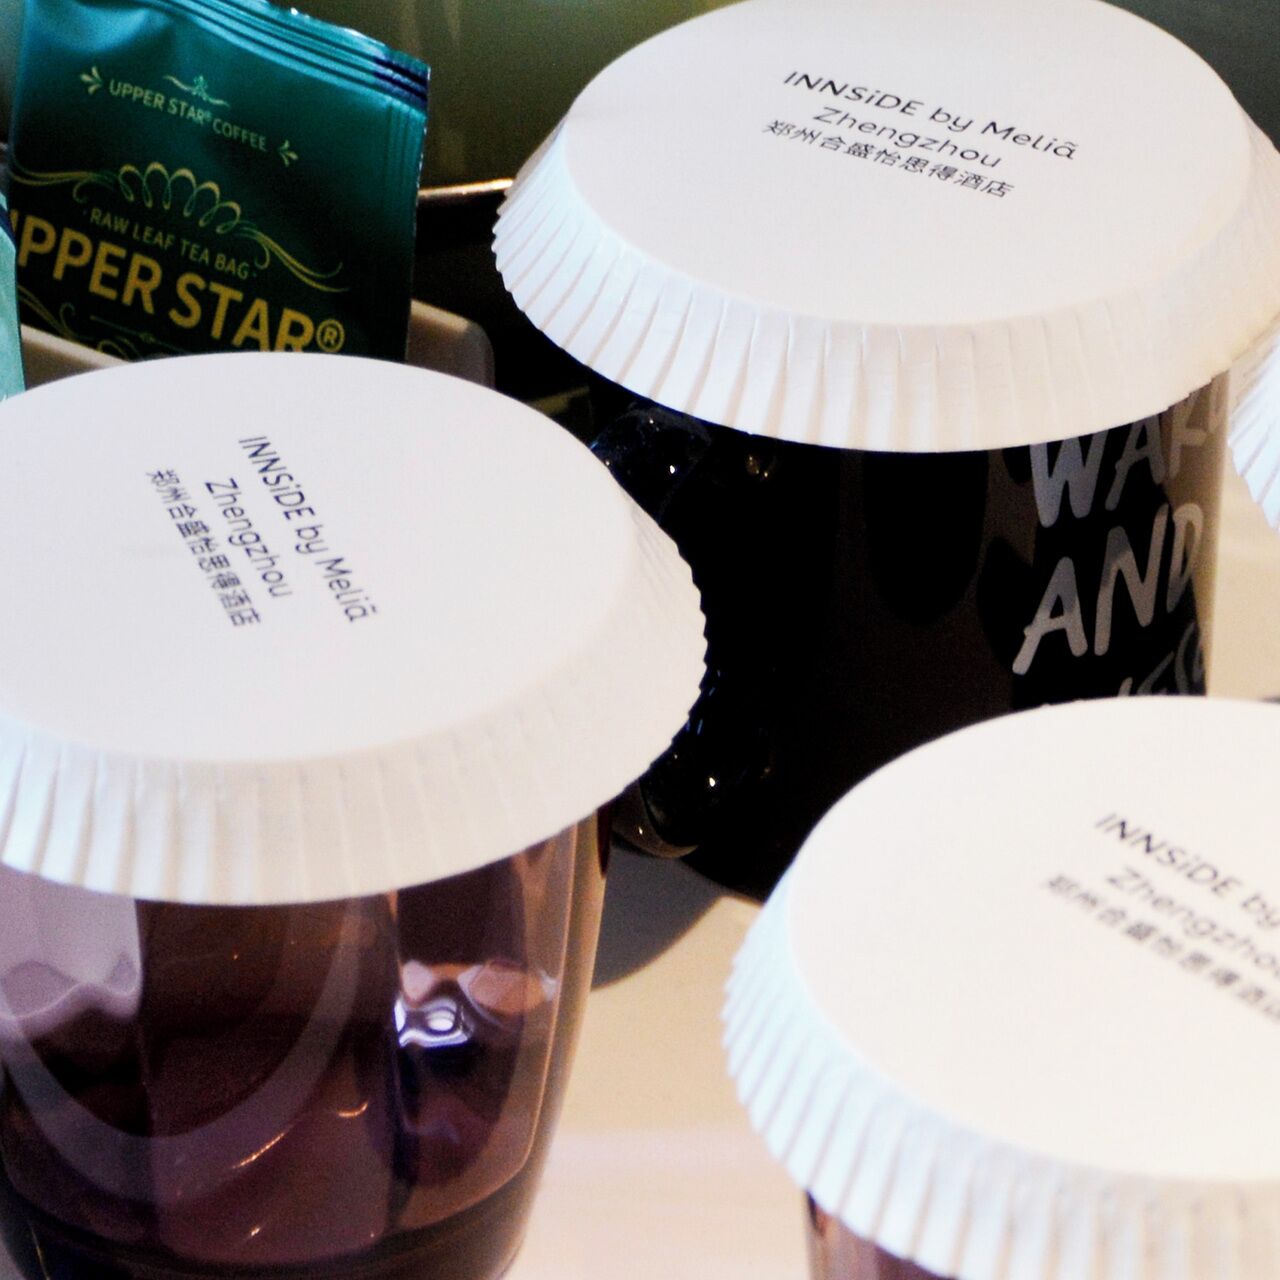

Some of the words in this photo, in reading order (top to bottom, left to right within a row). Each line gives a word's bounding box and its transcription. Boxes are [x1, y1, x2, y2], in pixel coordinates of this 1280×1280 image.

[108, 78, 165, 109] UPPER
[212, 119, 267, 152] COFFEE
[783, 70, 925, 117] INNSiDE
[928, 107, 974, 133] by
[813, 106, 1004, 169] Zhengzhou
[9, 208, 164, 316] PPER
[169, 271, 345, 353] STAR®
[89, 207, 129, 235] RAW
[133, 223, 175, 250] LEAF
[180, 239, 210, 265] TEA
[215, 253, 250, 281] BAG
[204, 477, 294, 599] Zhengzhou
[294, 523, 329, 554] by
[1012, 503, 1205, 676] AND
